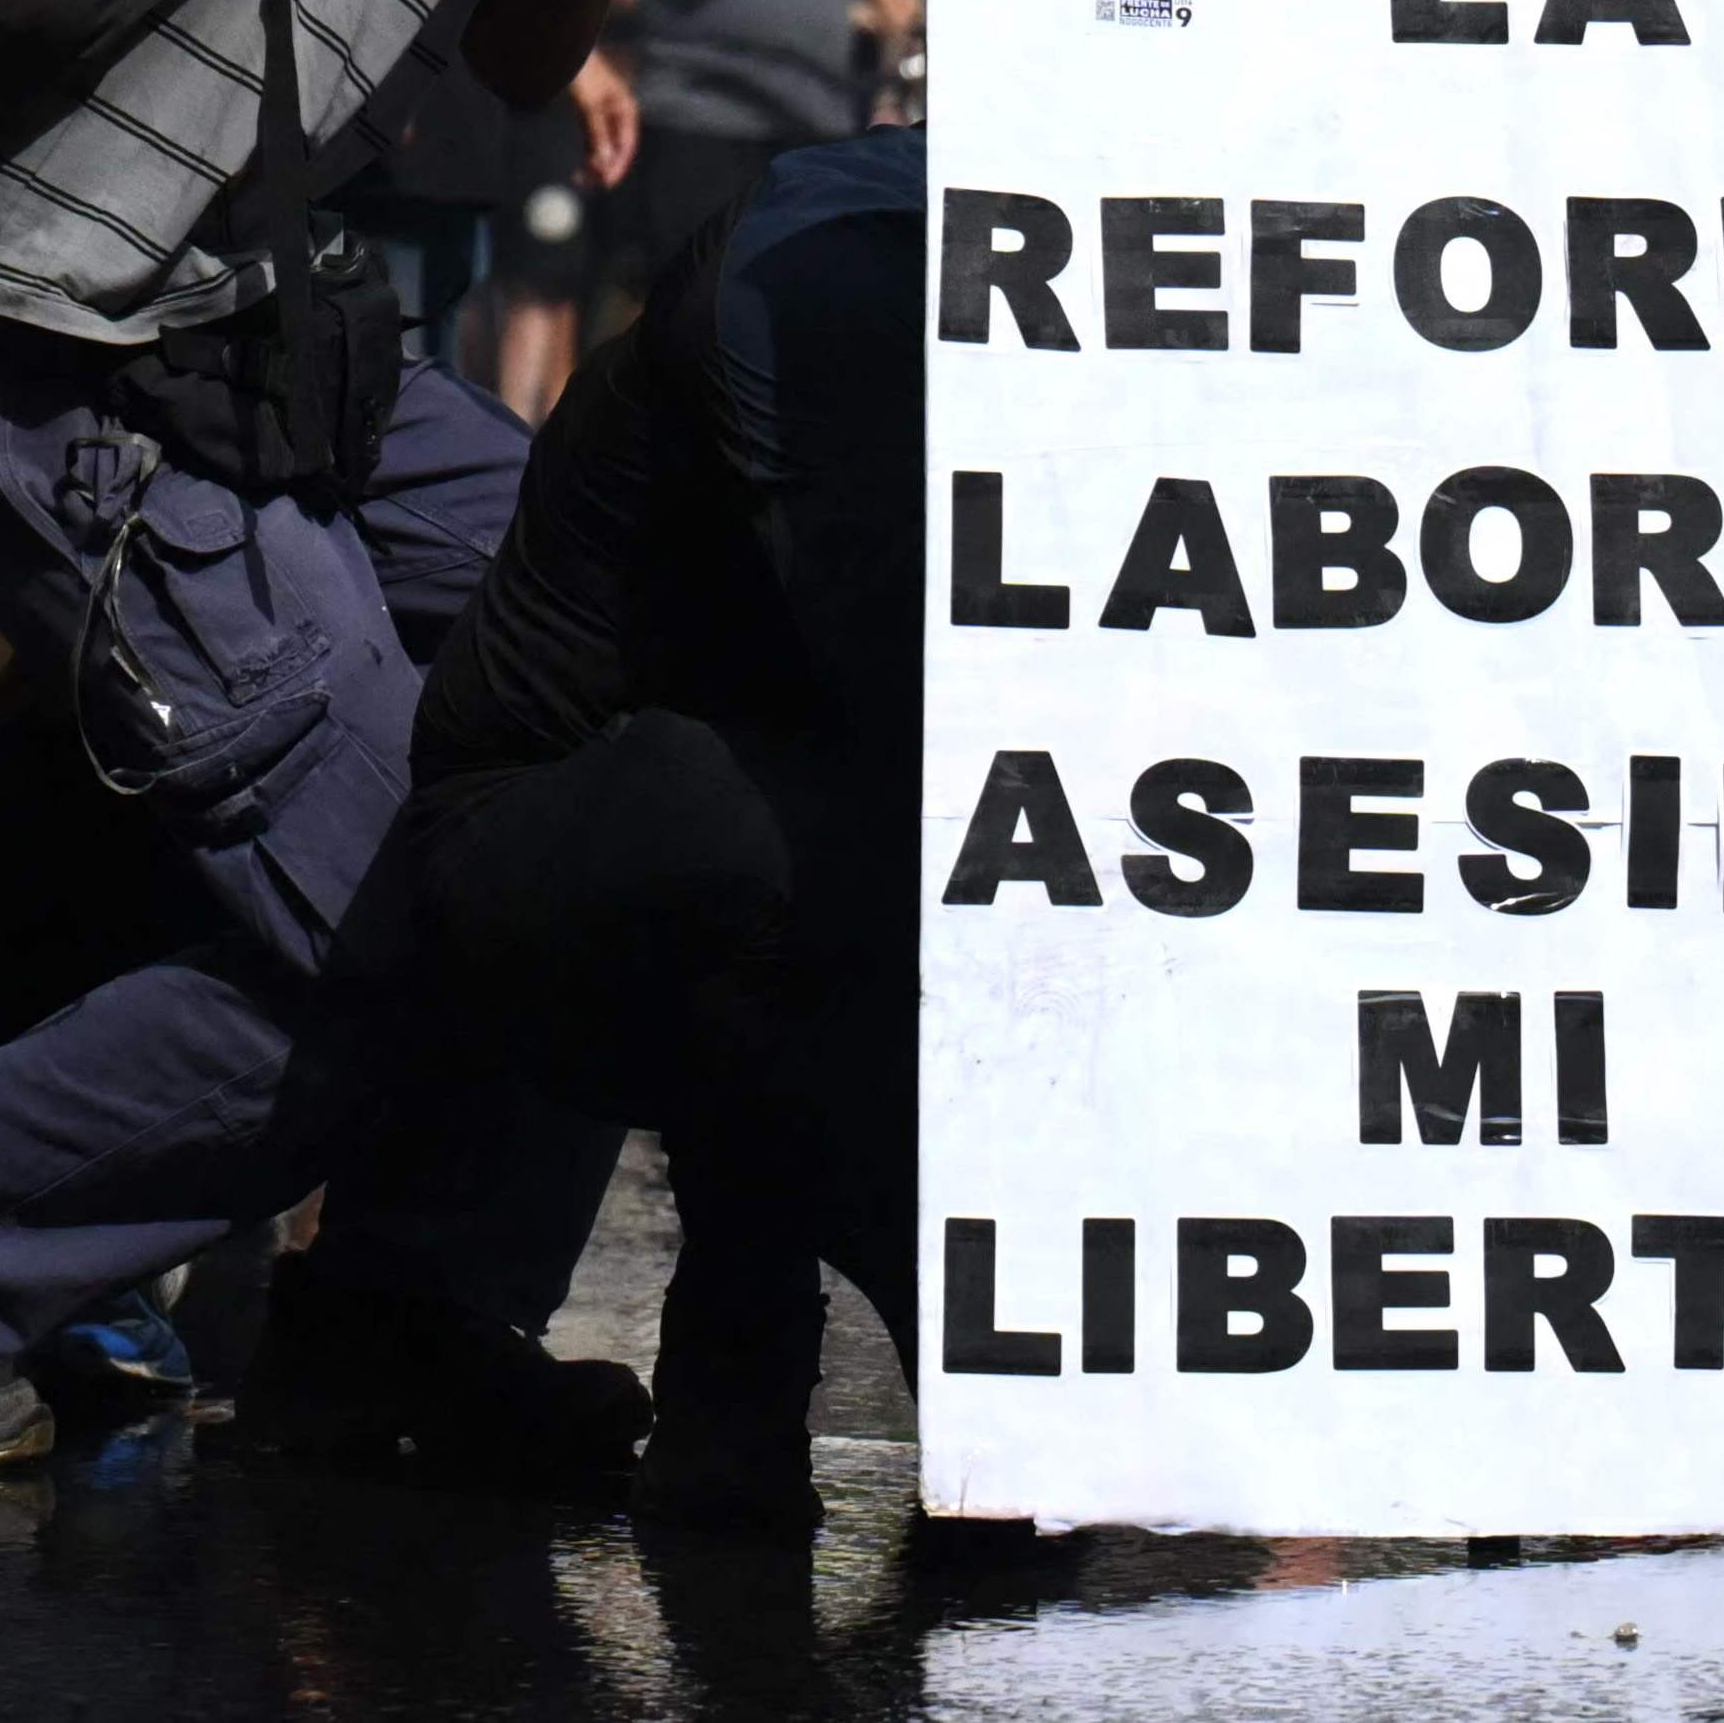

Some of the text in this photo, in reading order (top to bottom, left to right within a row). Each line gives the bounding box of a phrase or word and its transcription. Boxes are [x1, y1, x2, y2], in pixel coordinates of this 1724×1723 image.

[1121, 7, 1171, 19] LUCHA
[1175, 7, 1192, 27] 9
[1358, 991, 1608, 1146] MI
